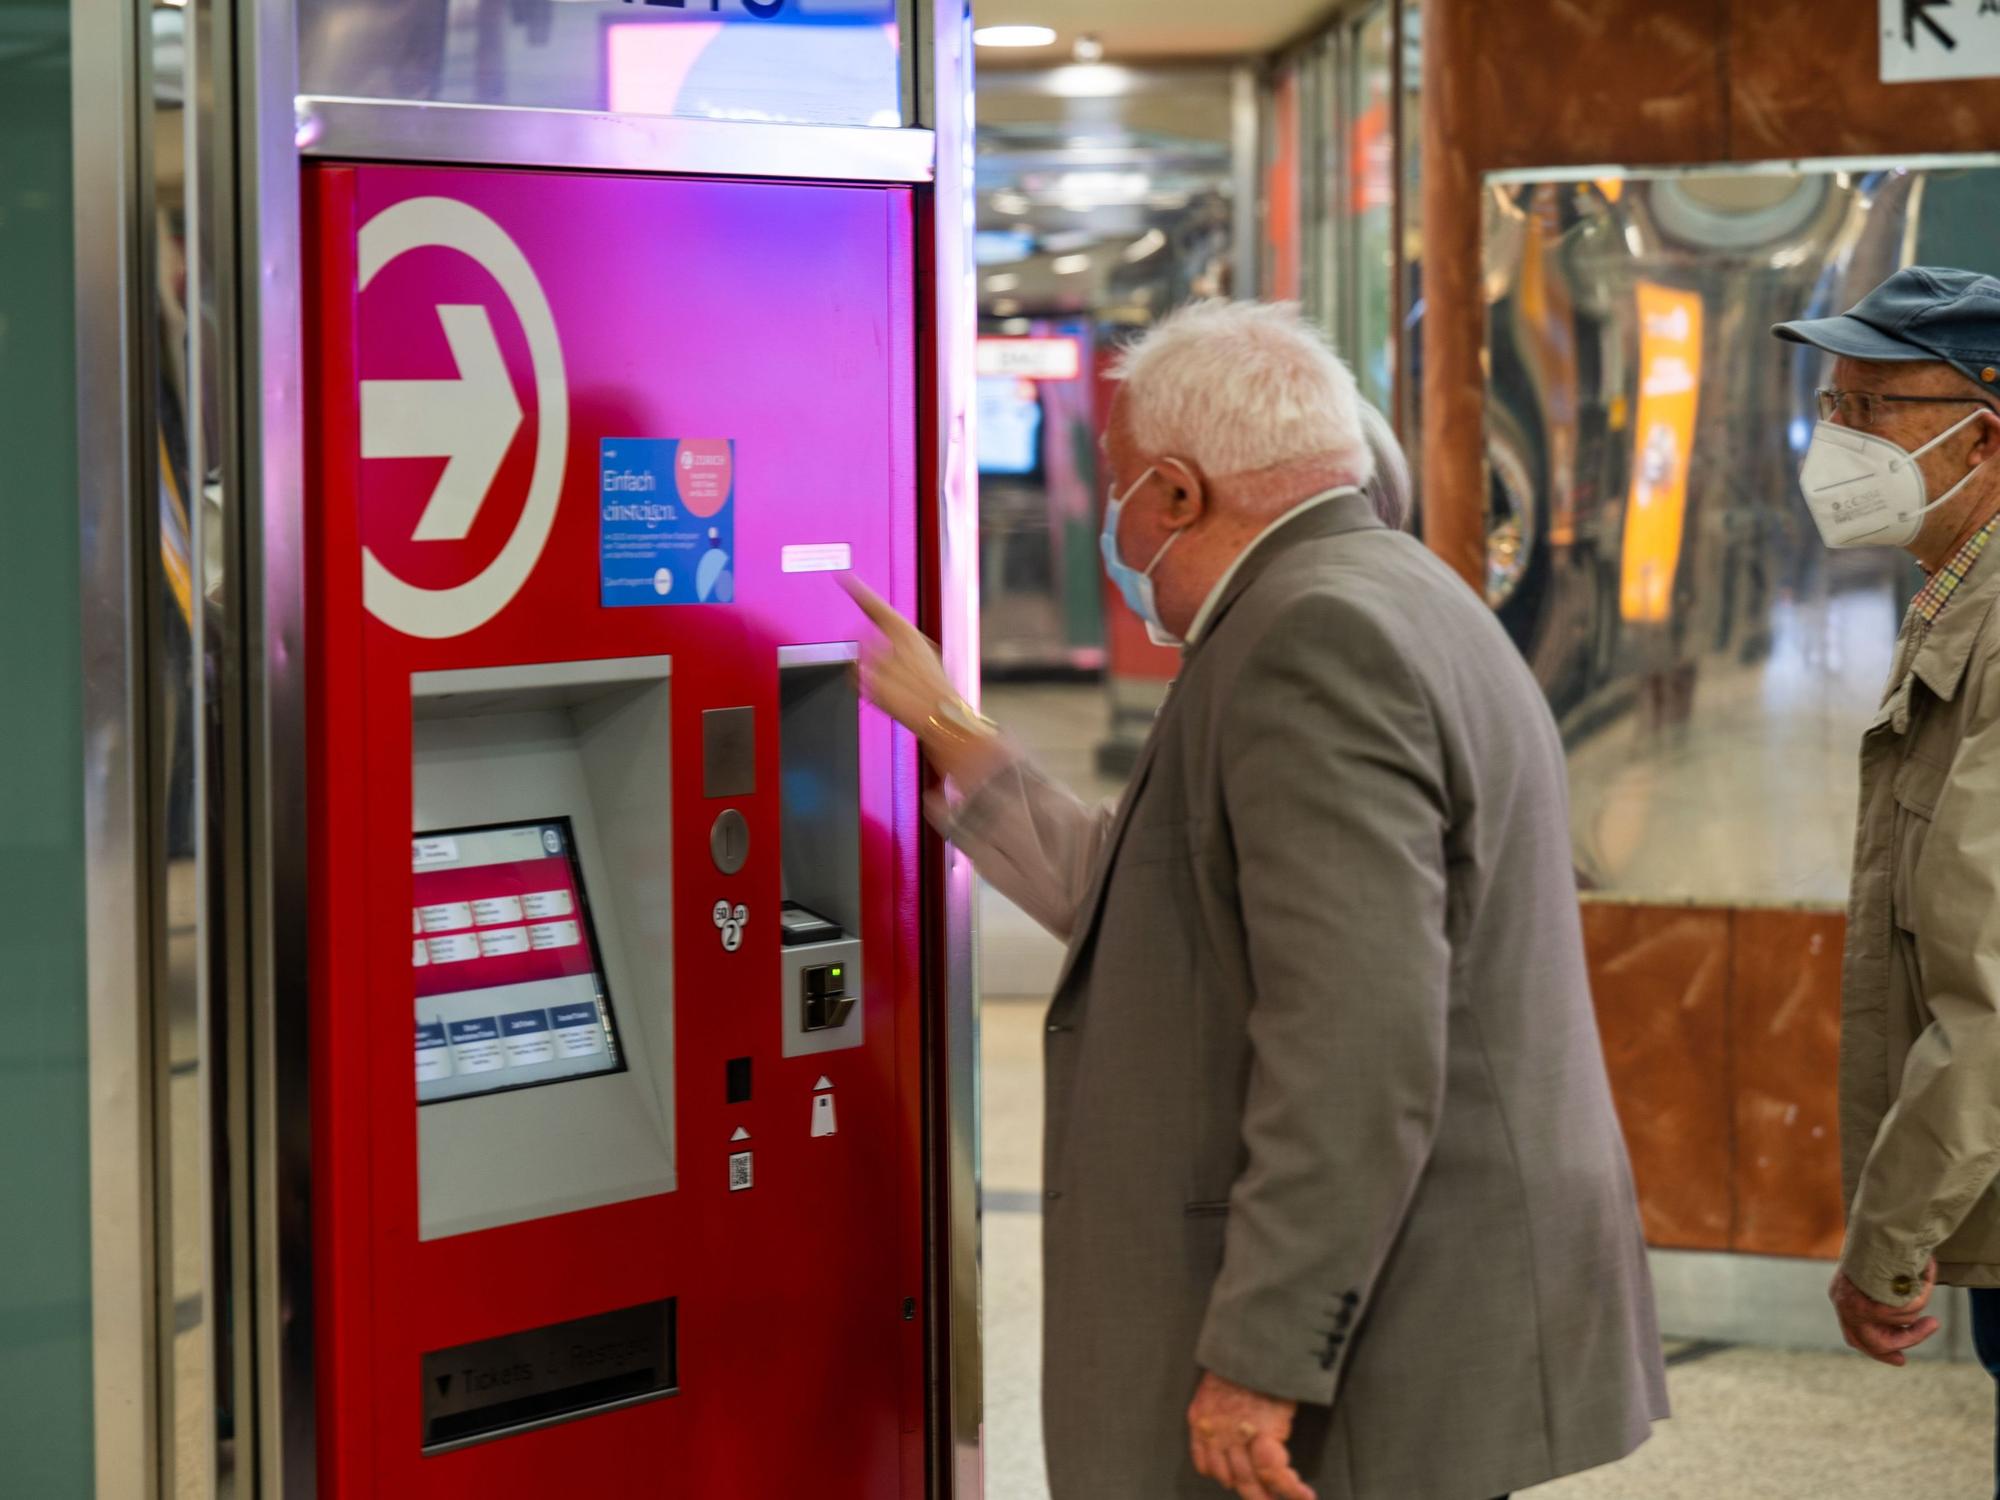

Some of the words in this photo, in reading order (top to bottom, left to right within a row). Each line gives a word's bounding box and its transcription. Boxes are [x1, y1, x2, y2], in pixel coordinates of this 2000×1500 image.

[603, 469, 656, 492] Einfach
[715, 907, 728, 921] 50
[726, 923, 737, 946] 2
[462, 1361, 534, 1393] Tickets
